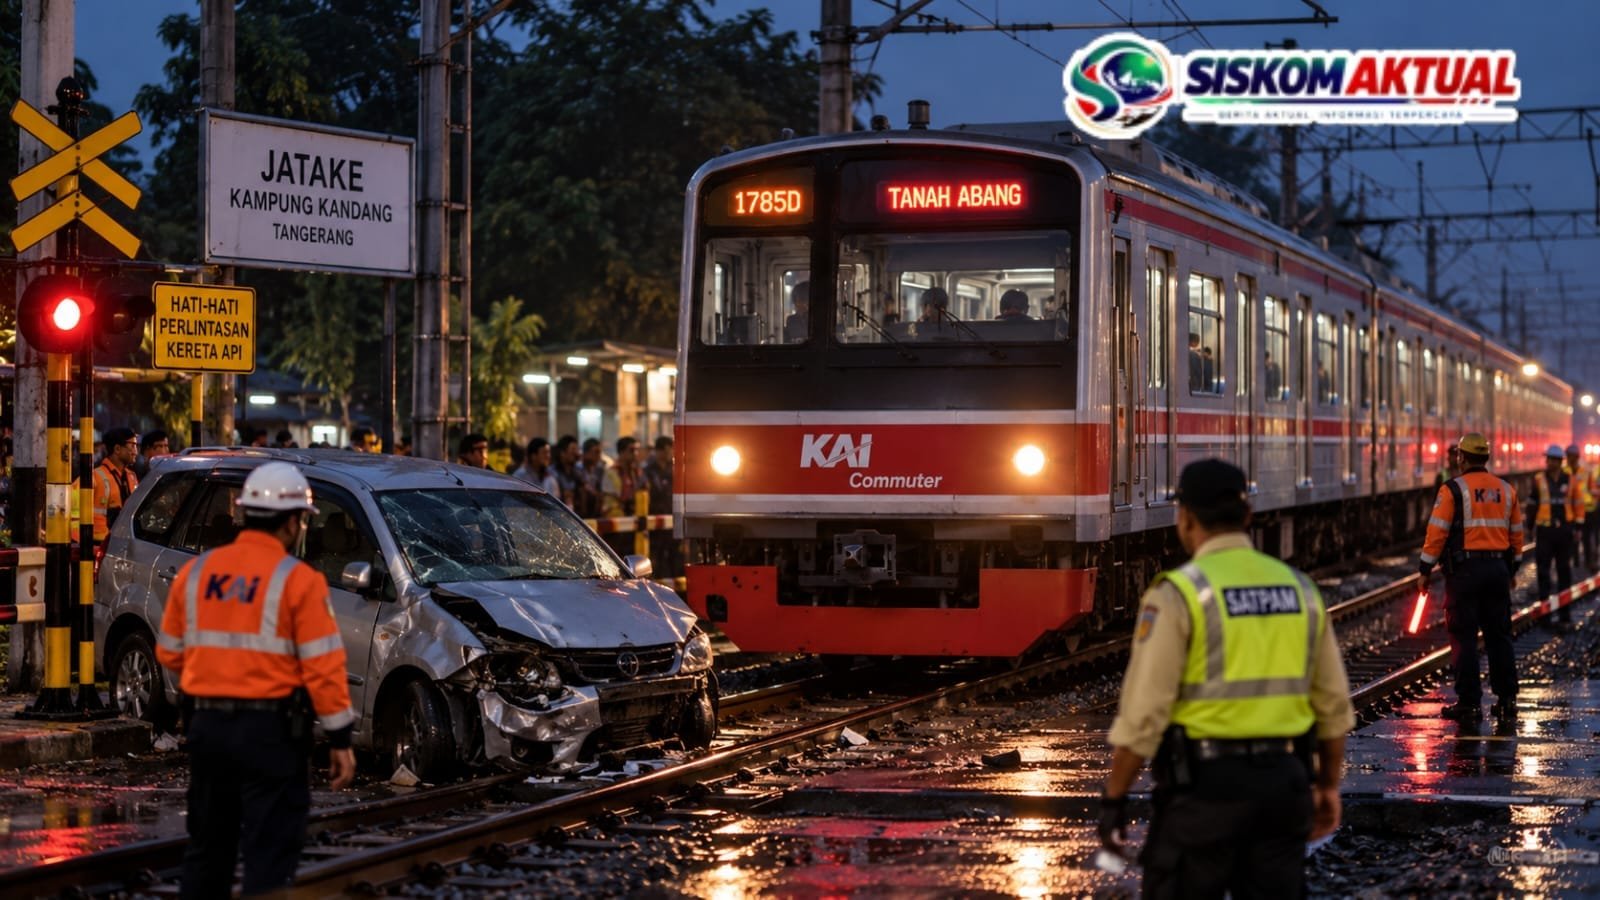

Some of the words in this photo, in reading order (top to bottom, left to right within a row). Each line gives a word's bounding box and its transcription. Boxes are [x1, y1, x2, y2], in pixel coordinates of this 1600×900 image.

[261, 150, 363, 192] JATAKE
[230, 188, 313, 215] KAMPUNG
[319, 197, 392, 223] KANDANG
[736, 190, 801, 214] 1785D
[888, 185, 950, 209] TANAH
[957, 184, 1021, 207] ABANG
[273, 223, 353, 246] TANGERANG
[171, 295, 238, 315] HATI-HATI
[160, 318, 248, 338] PERLINTASAN
[167, 341, 218, 359] KERETA
[222, 344, 242, 360] API
[800, 434, 872, 468] KAI
[850, 472, 942, 488] Commuter
[1226, 587, 1298, 614] SATPAM
